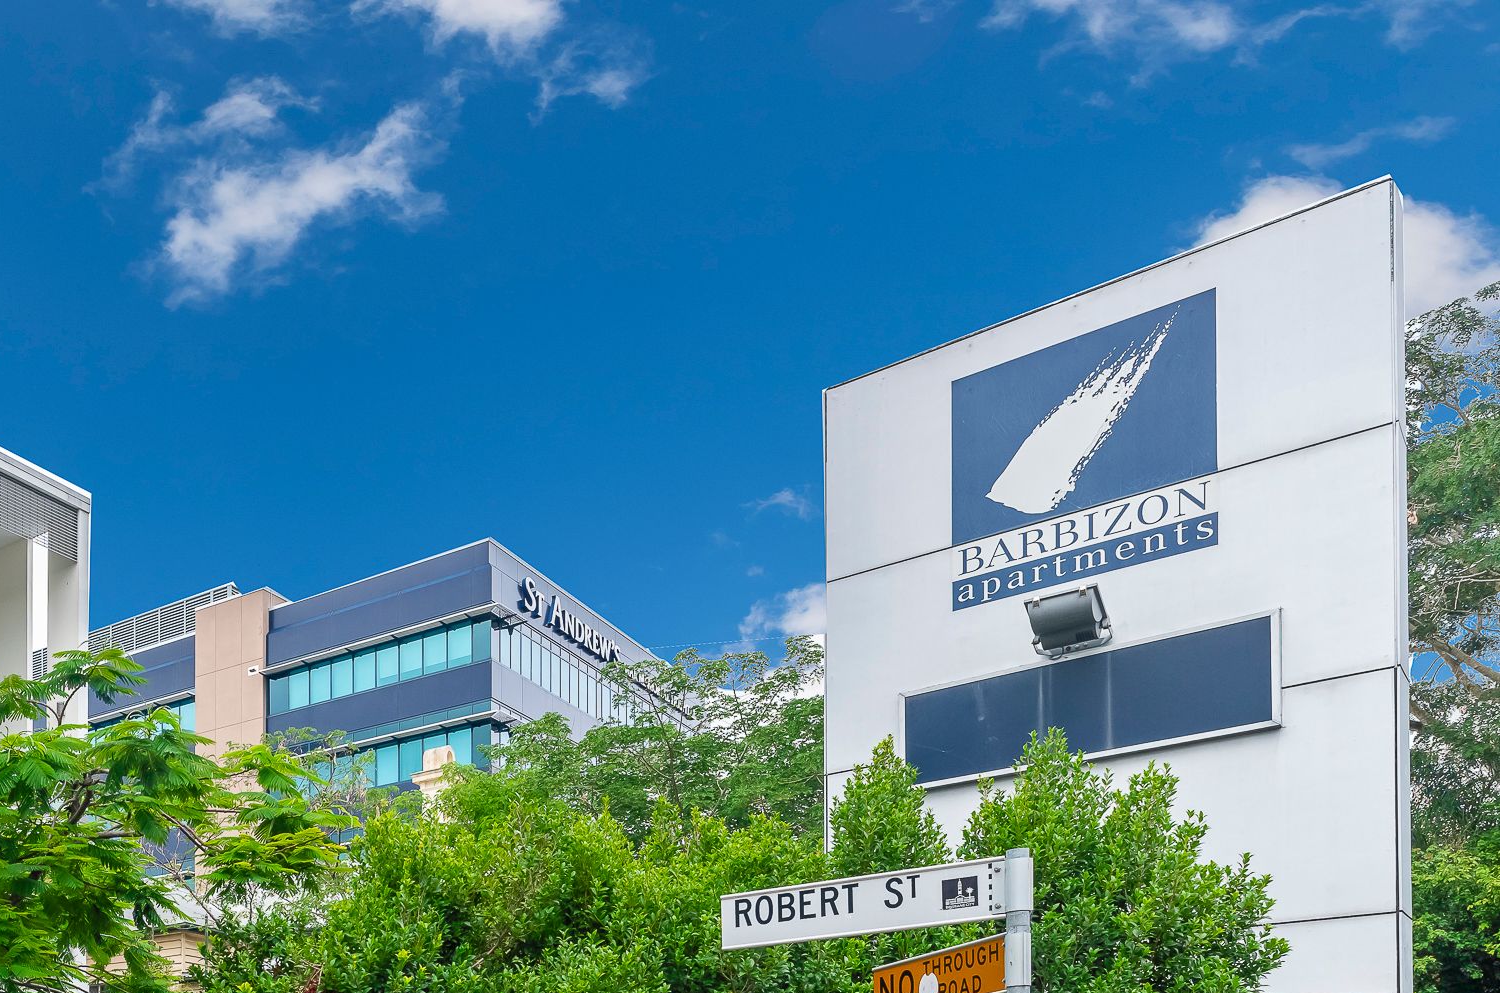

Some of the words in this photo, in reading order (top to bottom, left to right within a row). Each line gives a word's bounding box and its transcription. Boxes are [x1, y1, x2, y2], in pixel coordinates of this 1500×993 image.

[956, 517, 1215, 603] apartments
[957, 480, 1212, 577] BARBIZON
[734, 882, 860, 928] ROBERT
[883, 874, 921, 909] ST
[922, 942, 999, 977] THROUGH
